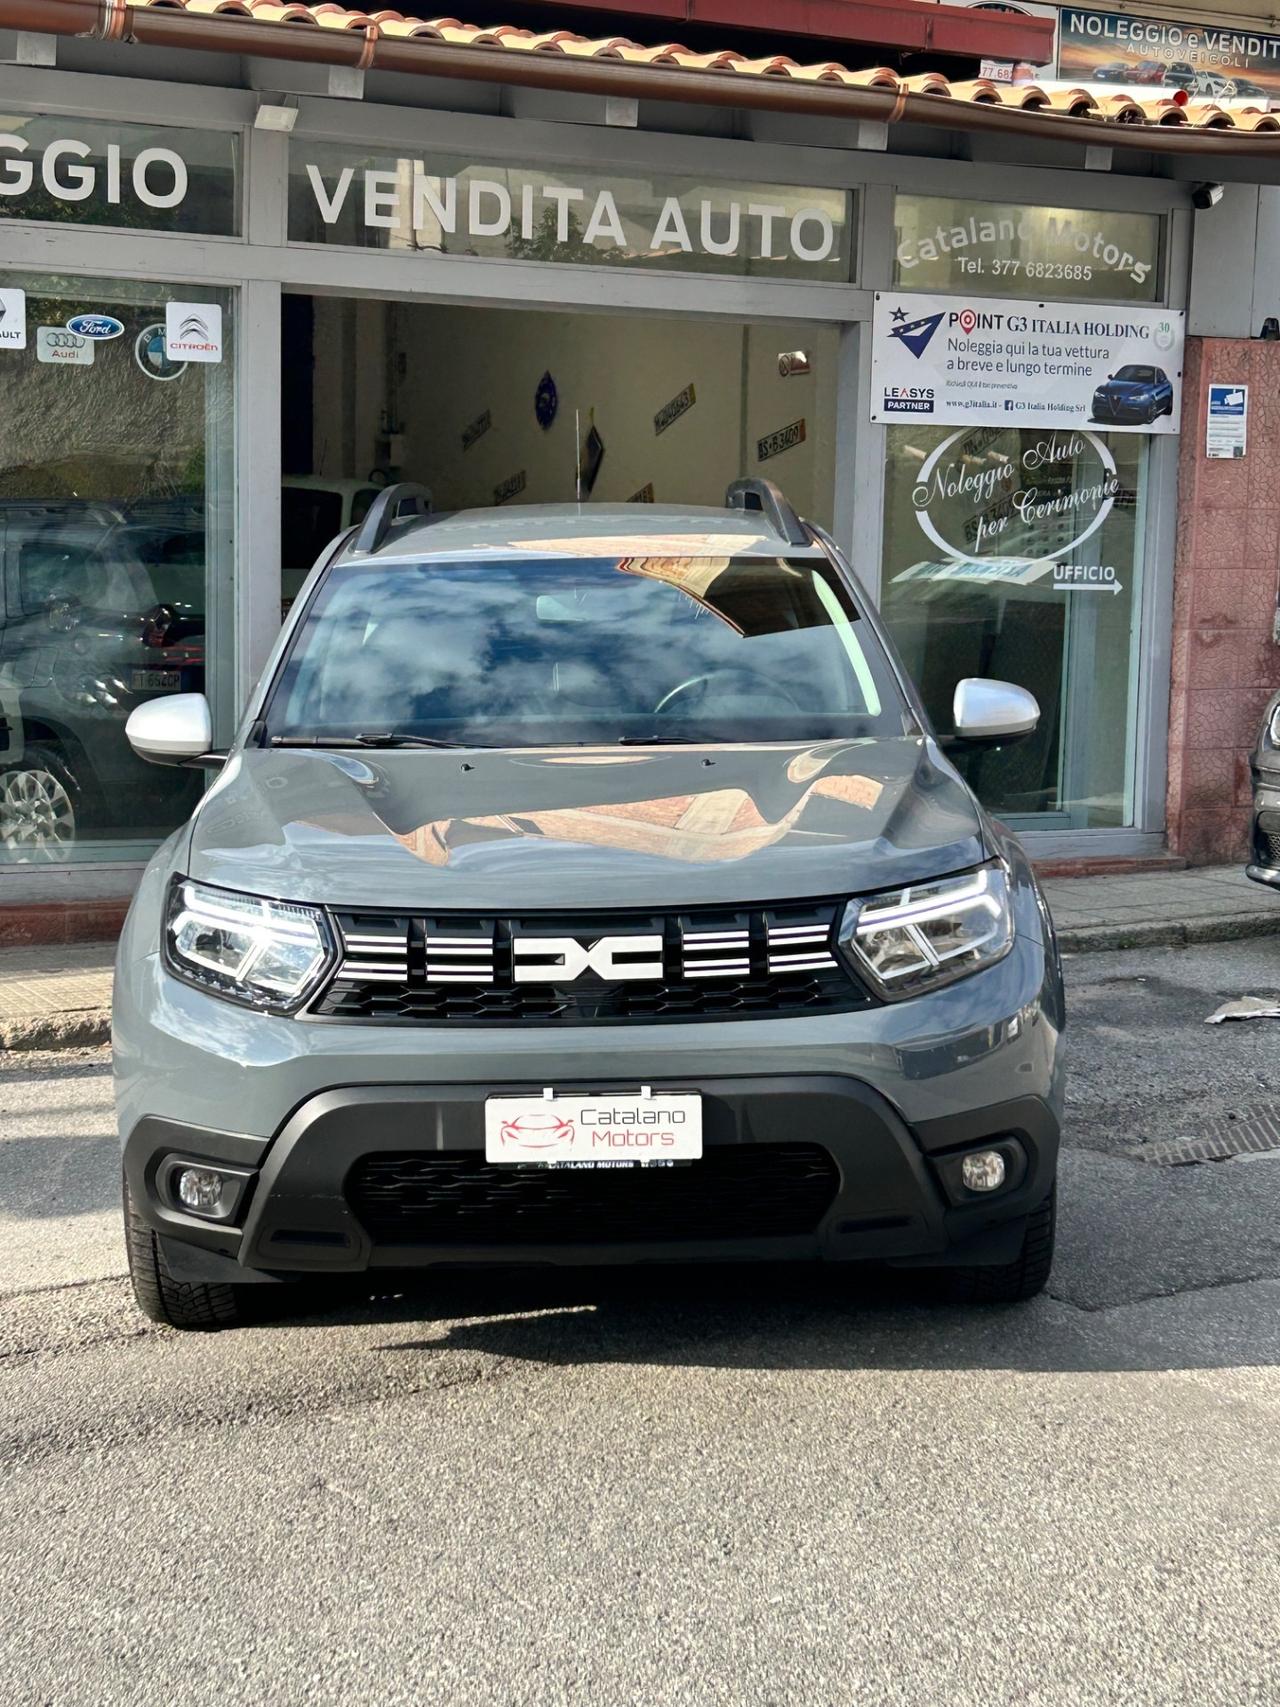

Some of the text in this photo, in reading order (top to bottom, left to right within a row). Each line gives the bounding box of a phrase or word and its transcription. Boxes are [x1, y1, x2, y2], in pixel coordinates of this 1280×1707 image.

[1070, 14, 1280, 59] NOLEGGIO e VENDIT
[1126, 42, 1250, 69] AUTOVEICOLI
[0, 133, 188, 209] GGIO
[305, 163, 834, 262] VENDITA AUTO
[896, 216, 1152, 284] Catalano Motors
[958, 256, 1093, 281] Tel. 377 6823685
[79, 319, 111, 335] Ford
[948, 309, 1005, 335] POINT
[1006, 315, 1028, 332] G3
[1031, 319, 1081, 336] ITALIA
[1083, 321, 1150, 340] HOLDING
[0, 330, 21, 340] ULT
[51, 349, 79, 359] Audi
[947, 338, 1110, 360] Noleggia qui la tua vettura
[946, 357, 1092, 377] a breve e lungo termine
[883, 387, 935, 399] LEASYS
[887, 401, 931, 411] PARTNER
[1015, 402, 1026, 411] G3
[1027, 403, 1046, 411] Italia
[1047, 403, 1075, 413] Holding
[1075, 404, 1086, 413] Srl
[912, 462, 1015, 508] Noleggio
[1022, 431, 1086, 470] Auto
[973, 514, 1009, 553] per
[1012, 472, 1120, 526] Cerimonie
[1053, 565, 1115, 582] UFFICIO
[580, 1107, 686, 1126] Catalano
[592, 1129, 675, 1148] Motors
[596, 1160, 635, 1169] MOTORS
